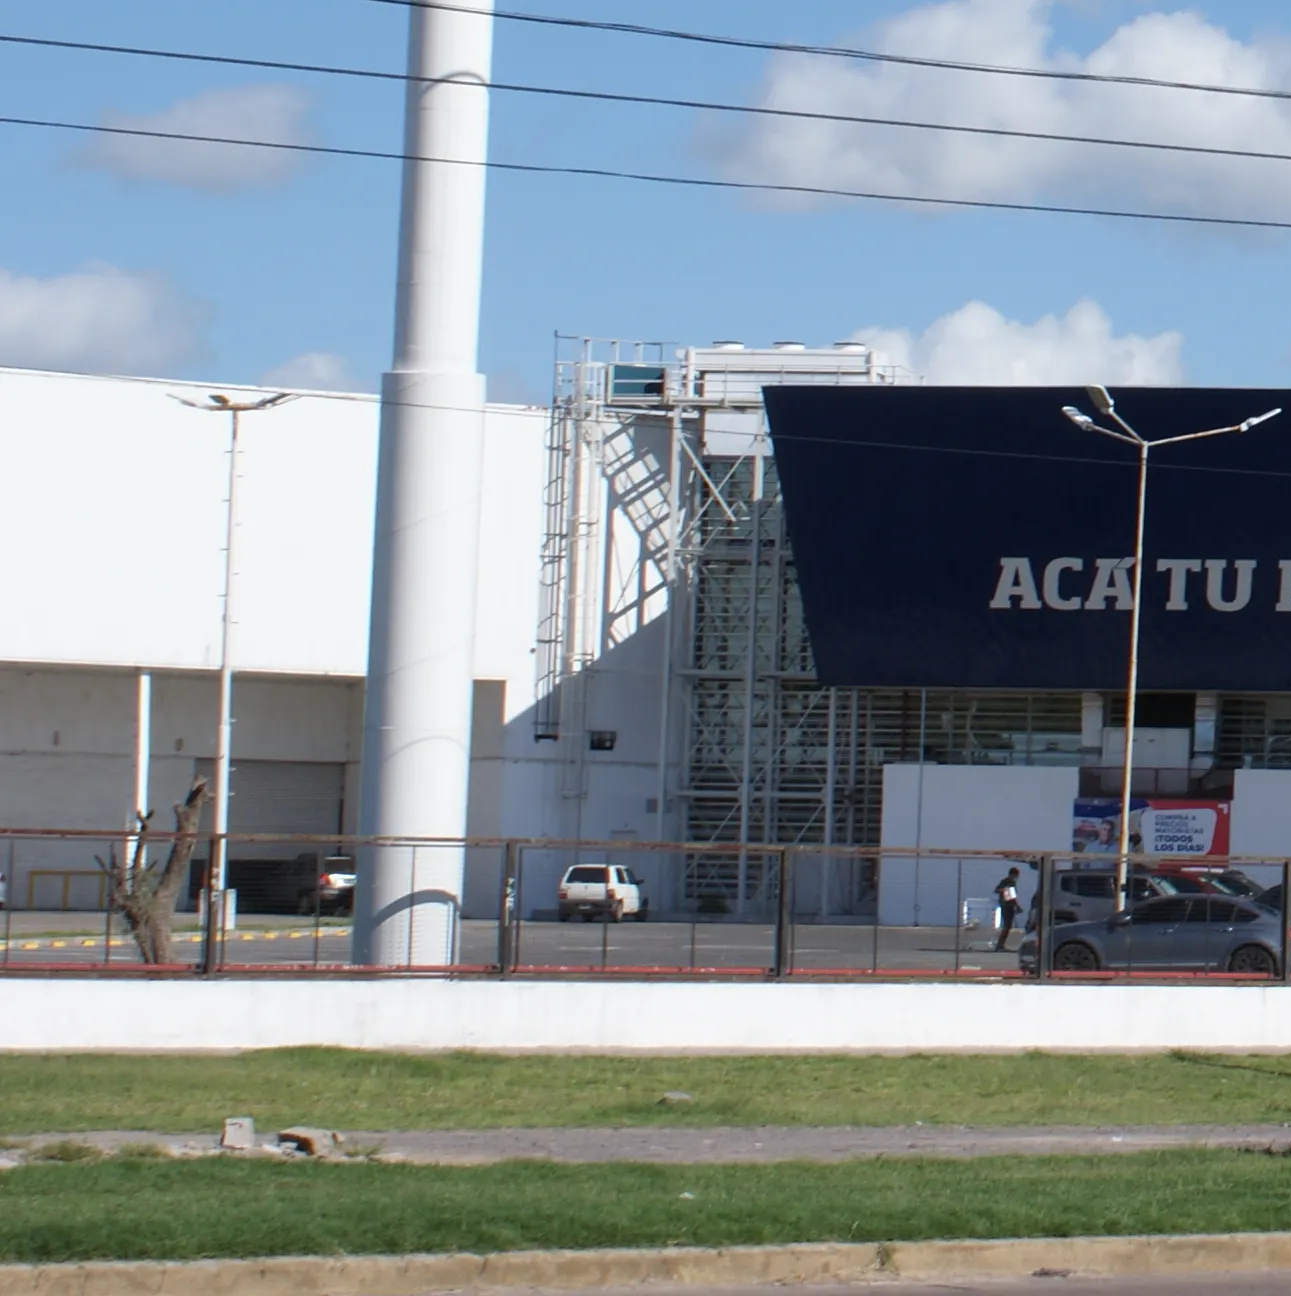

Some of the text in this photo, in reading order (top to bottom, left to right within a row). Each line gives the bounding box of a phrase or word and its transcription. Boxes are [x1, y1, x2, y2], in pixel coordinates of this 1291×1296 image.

[989, 556, 1137, 612] ACÁ
[1156, 558, 1258, 612] TU
[1154, 844, 1174, 852] LOS
